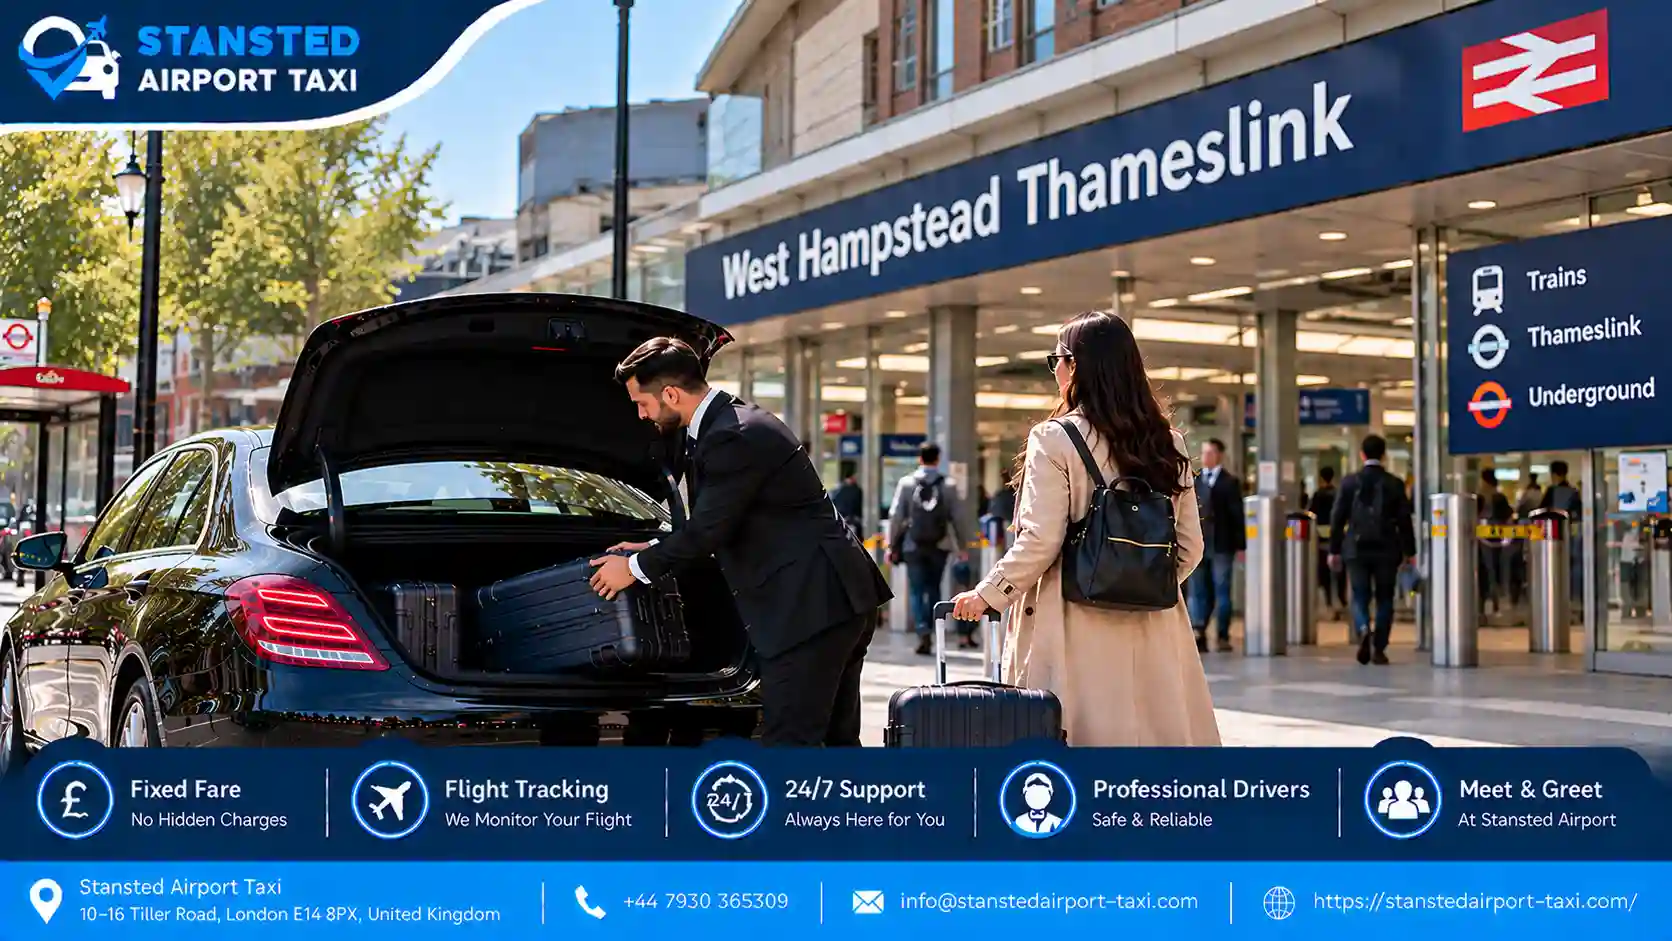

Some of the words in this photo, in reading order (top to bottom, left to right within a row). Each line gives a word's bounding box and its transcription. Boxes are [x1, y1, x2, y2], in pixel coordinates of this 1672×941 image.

[722, 241, 790, 300] West
[798, 178, 1001, 276] Hampstead
[1016, 80, 1355, 226] Thameslink
[1526, 266, 1588, 292] Trains
[1527, 314, 1643, 348] Thameslink
[1528, 376, 1656, 408] Underground
